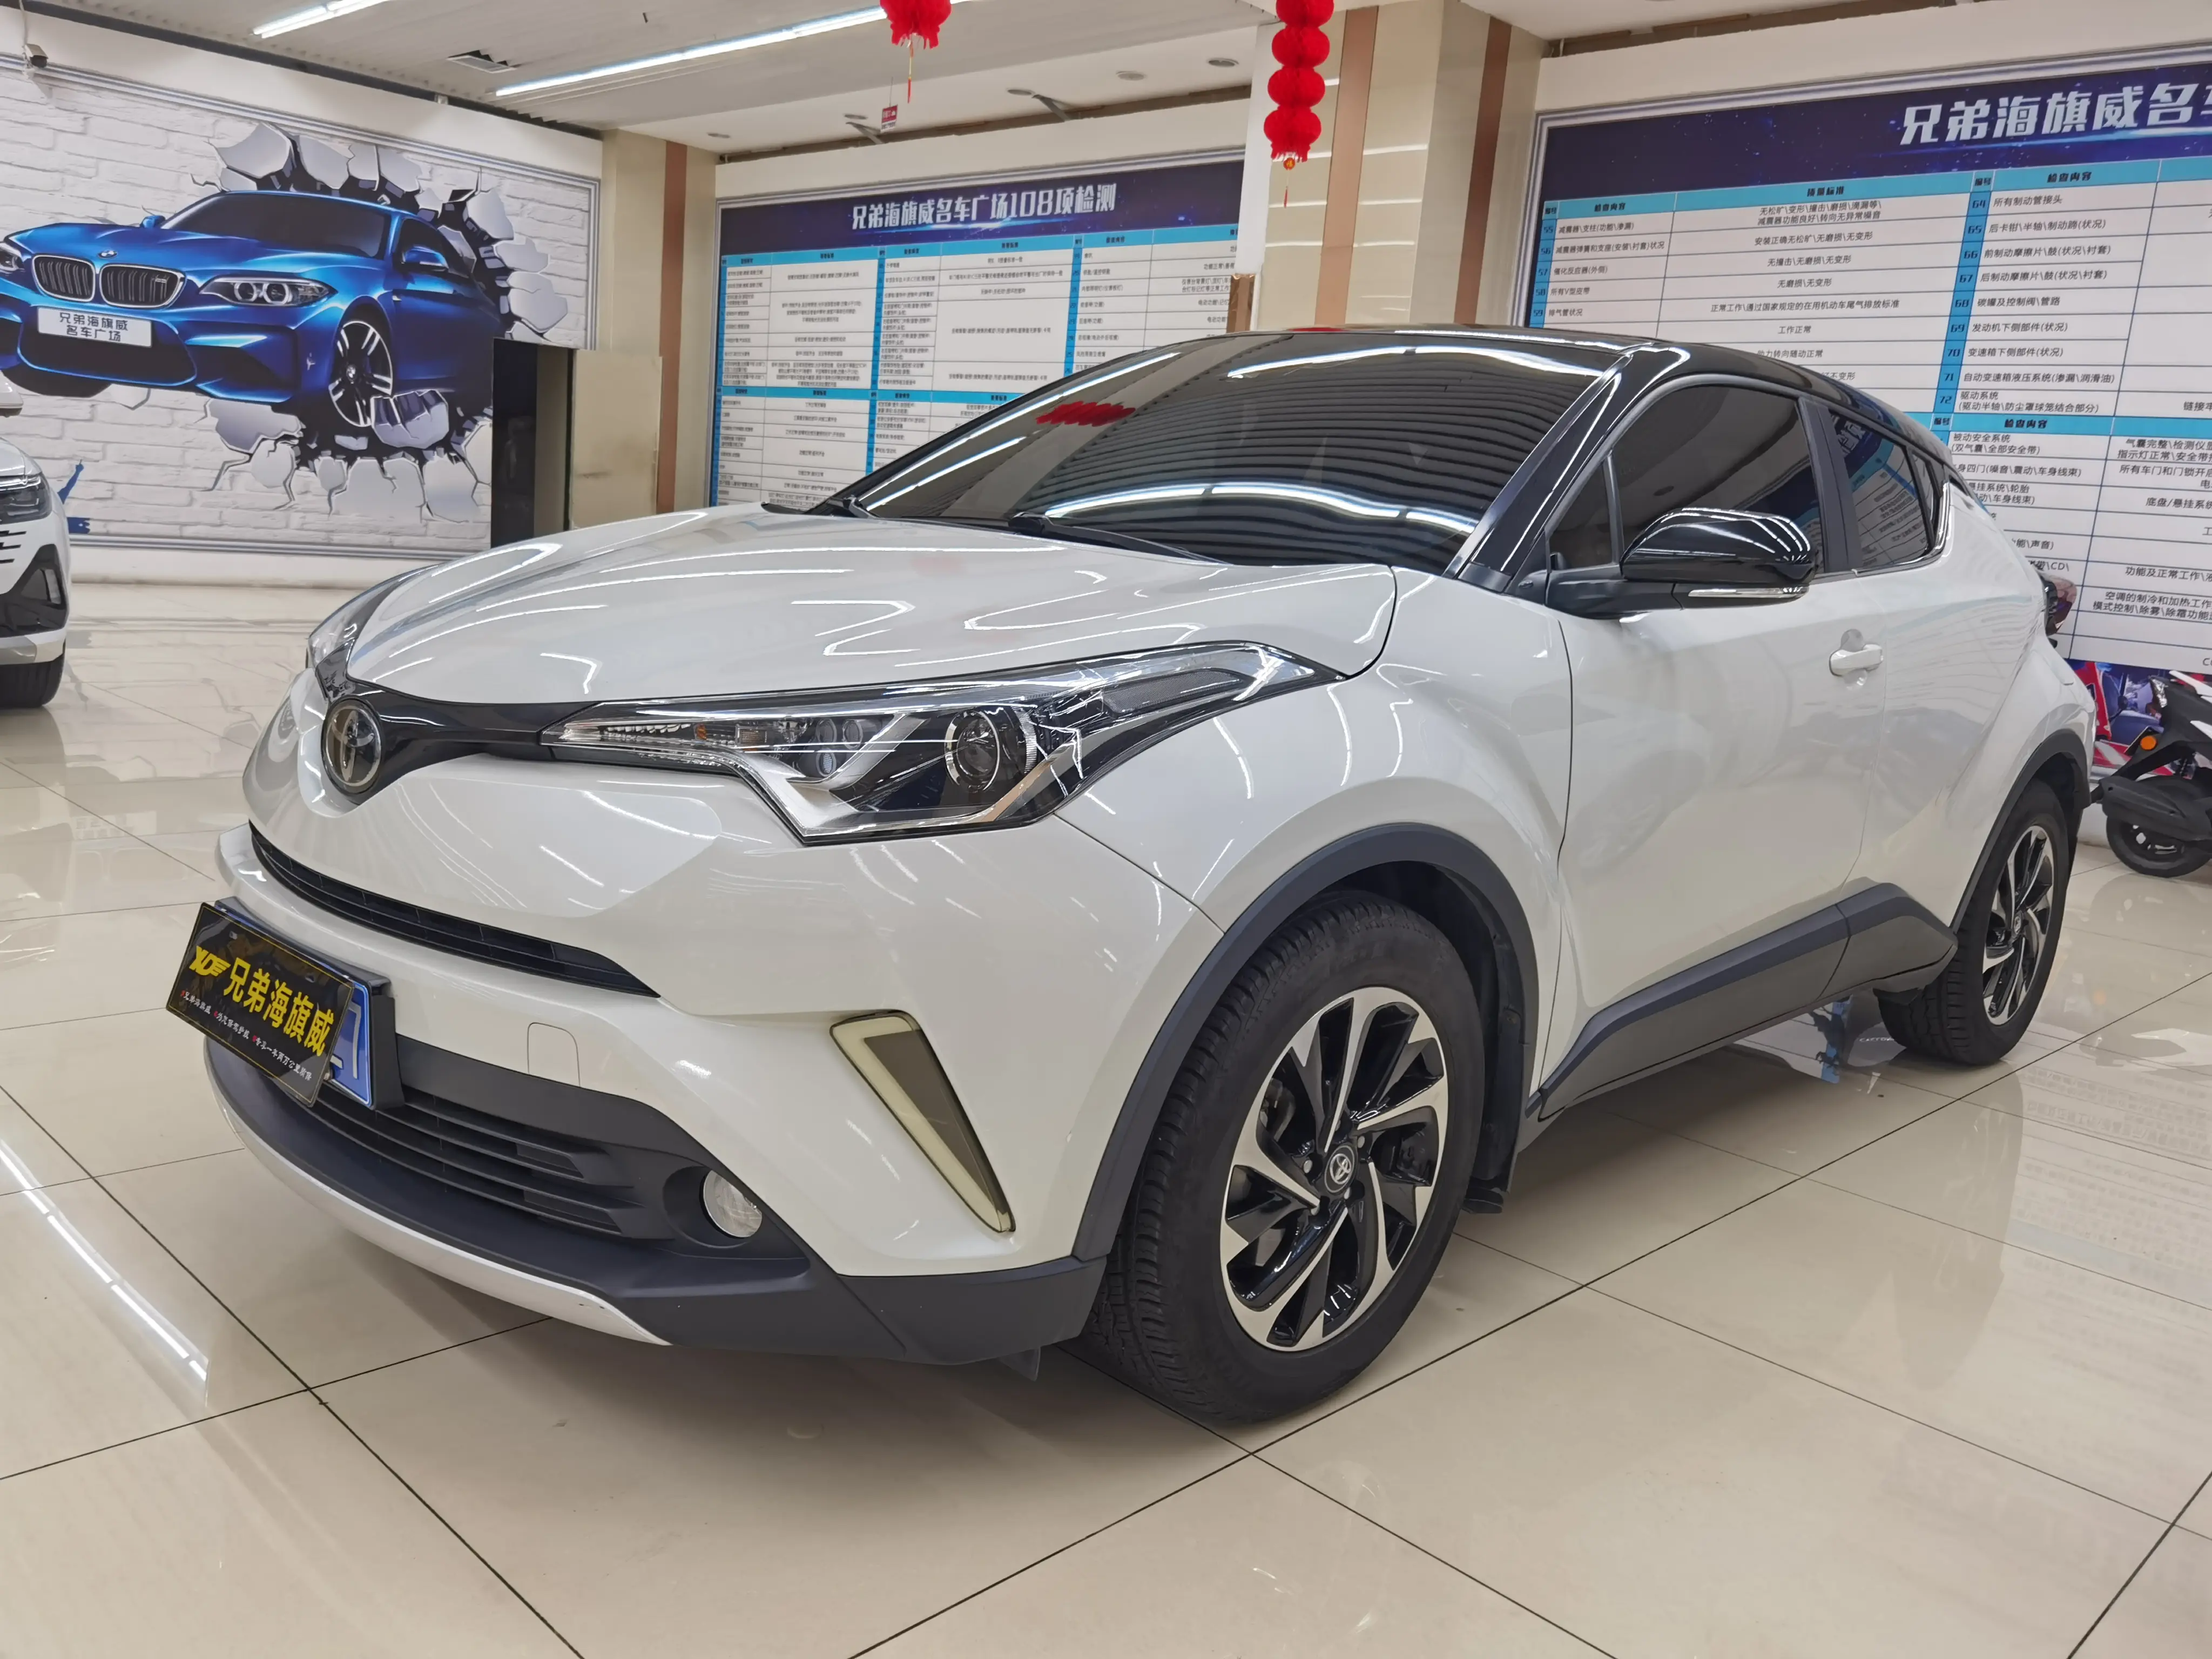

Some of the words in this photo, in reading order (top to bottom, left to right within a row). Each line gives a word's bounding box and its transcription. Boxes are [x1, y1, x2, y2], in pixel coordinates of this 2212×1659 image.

[1993, 194, 2063, 207] 所有制动管接头
[852, 183, 1117, 230] 兄弟海旗威名车广场108项检测
[1959, 274, 1973, 283] 67
[1550, 287, 1590, 296] 所有V型皮带
[59, 312, 129, 332] 兄弟海旗威
[1972, 322, 2068, 333] 发动机下侧部件(状况)
[66, 325, 121, 342] 名车广场
[1778, 325, 1811, 335] 工作正常
[1950, 324, 1965, 333] 69
[1968, 348, 2063, 358] 变速箱下侧部件(状况)
[1940, 395, 1953, 404] 72
[1960, 391, 1999, 401] 驱动系统
[1953, 433, 2011, 443] 被动安全系统
[1951, 444, 2041, 456] (双气囊\全部安全带)
[2117, 449, 2212, 463] 指示灯正常\安全带
[1953, 464, 2082, 477] 身四门(噪音\震动\车身线束)
[2200, 480, 2212, 489] 电
[1974, 494, 2035, 505] 动\车身线束)
[2012, 538, 2054, 550] 能\声音)
[2093, 601, 2212, 621] 模式控制\除雾\除霜功能
[223, 957, 335, 1057] 兄弟海旗威
